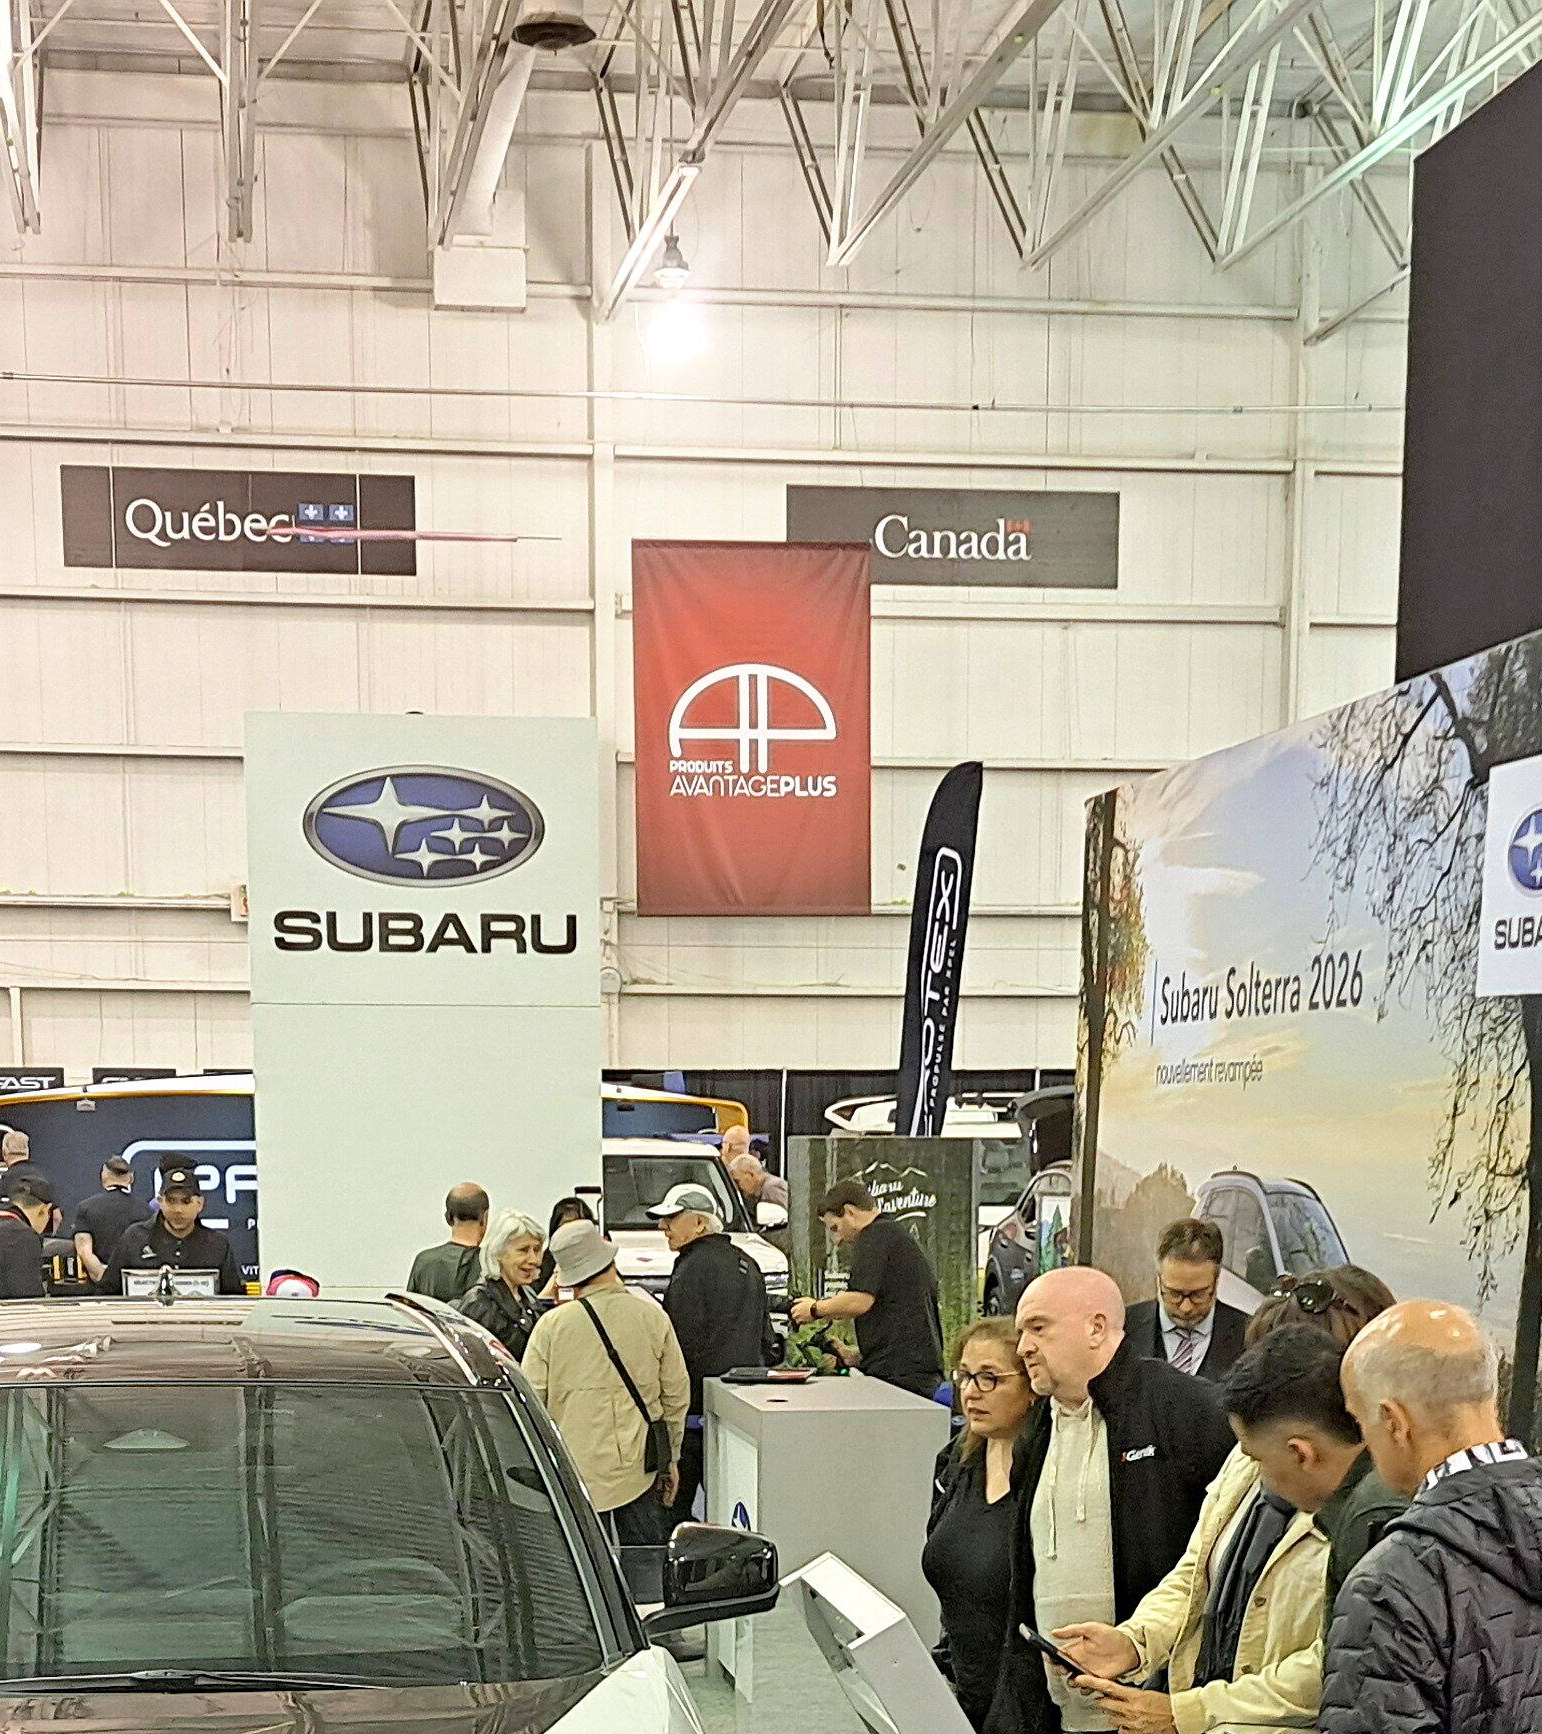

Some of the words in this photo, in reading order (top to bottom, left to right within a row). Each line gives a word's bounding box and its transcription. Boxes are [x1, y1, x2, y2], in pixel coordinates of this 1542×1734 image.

[125, 499, 294, 547] Québec
[874, 514, 1031, 560] Canada
[669, 760, 734, 773] PRODUITS
[669, 775, 837, 797] AVANTAGEPLUS
[274, 909, 578, 955] SUBARU
[1160, 970, 1219, 1026] Subaru
[1225, 960, 1301, 1020] Solterra
[1308, 949, 1363, 1011] 2026
